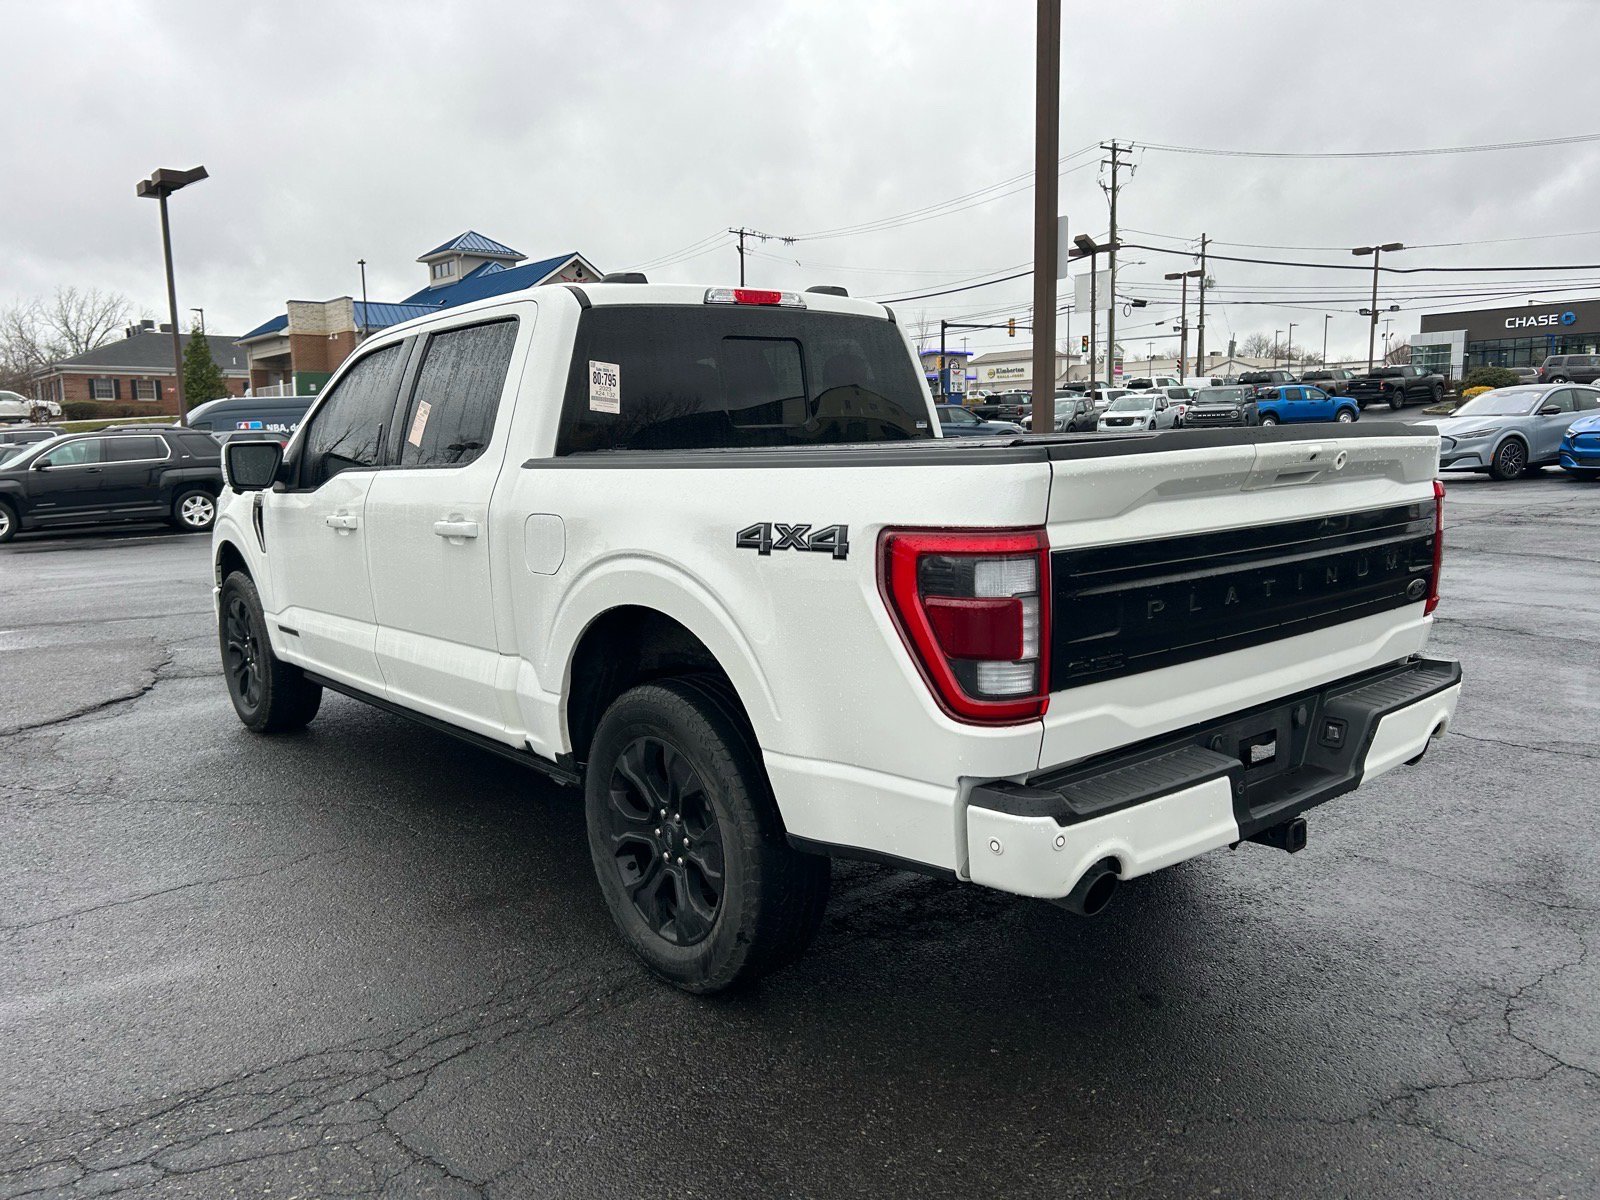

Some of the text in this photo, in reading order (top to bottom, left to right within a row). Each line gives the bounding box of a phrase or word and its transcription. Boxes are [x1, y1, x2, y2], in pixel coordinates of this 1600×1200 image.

[1505, 314, 1559, 329] CHASE
[593, 371, 617, 387] 80:795
[1148, 552, 1398, 619] PLATINUM
